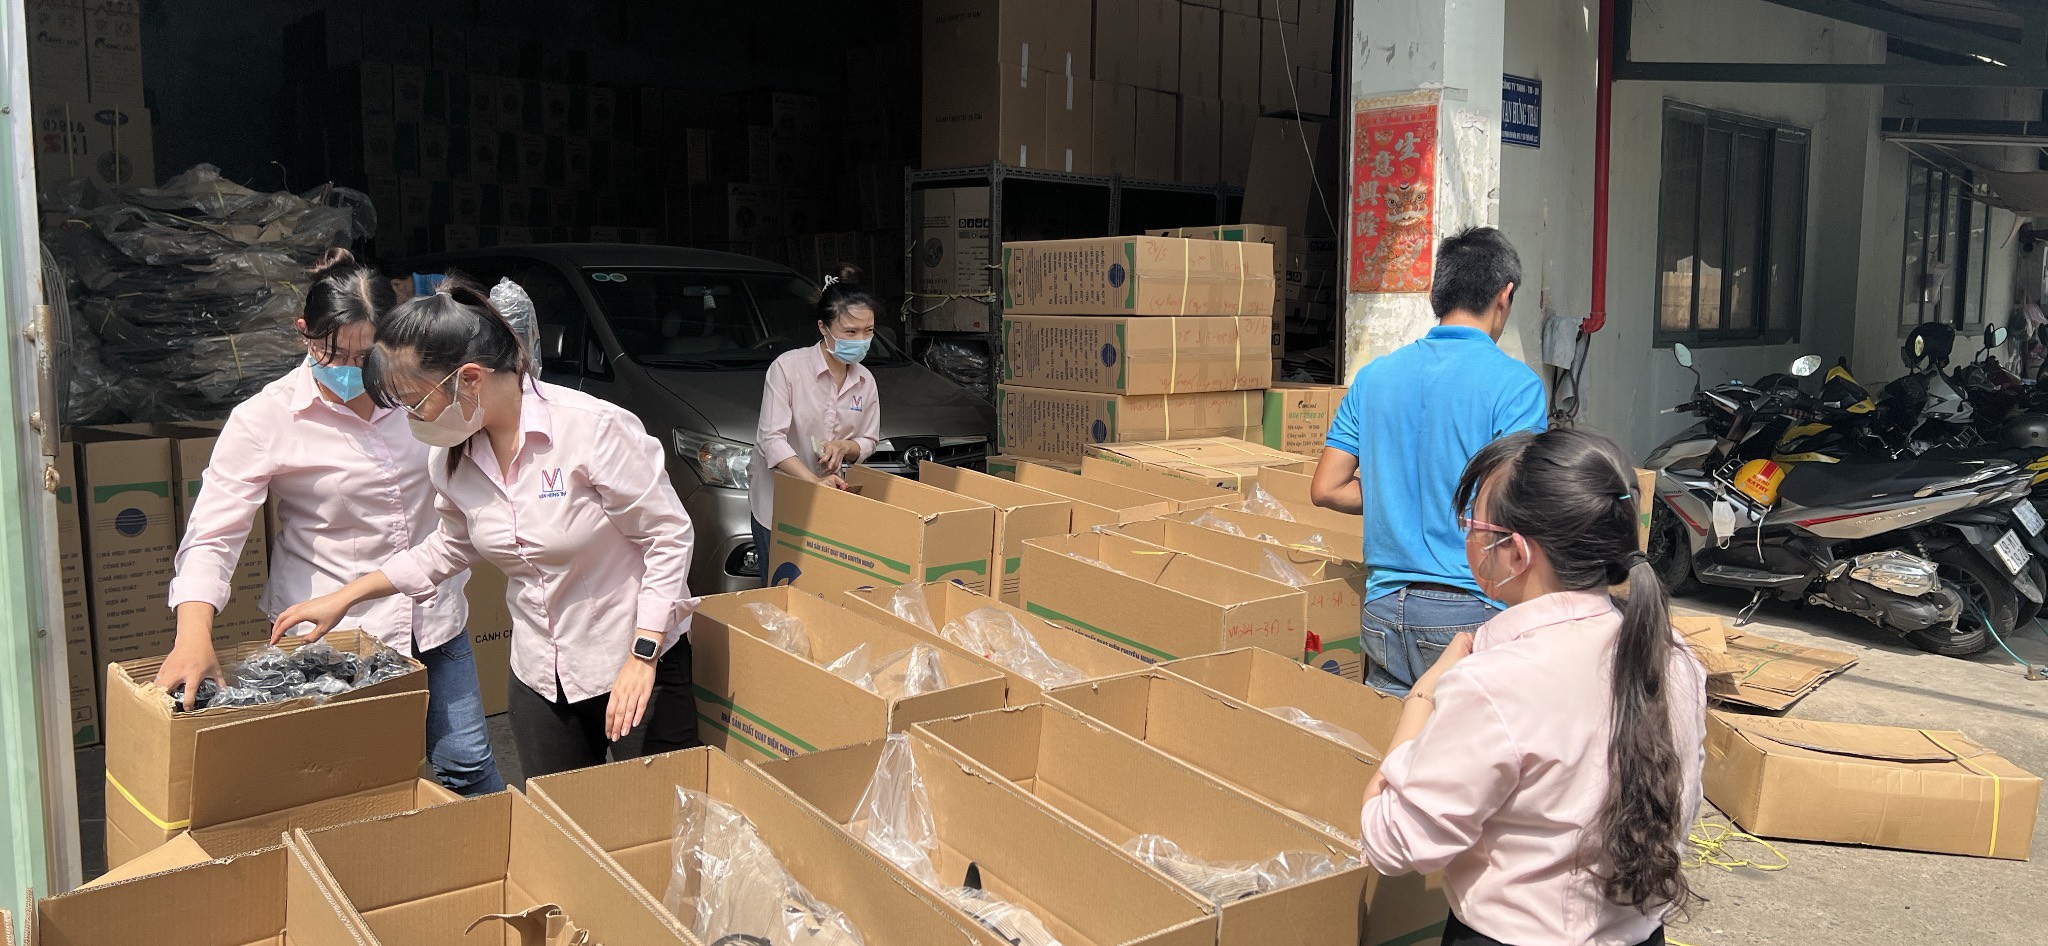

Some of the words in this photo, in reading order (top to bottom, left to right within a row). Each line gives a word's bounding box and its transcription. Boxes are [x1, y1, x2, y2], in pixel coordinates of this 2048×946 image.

[731, 715, 742, 730] SẢN
[742, 724, 755, 737] XUẤT
[754, 730, 767, 743] QUẠT
[767, 736, 779, 750] ĐIỆN
